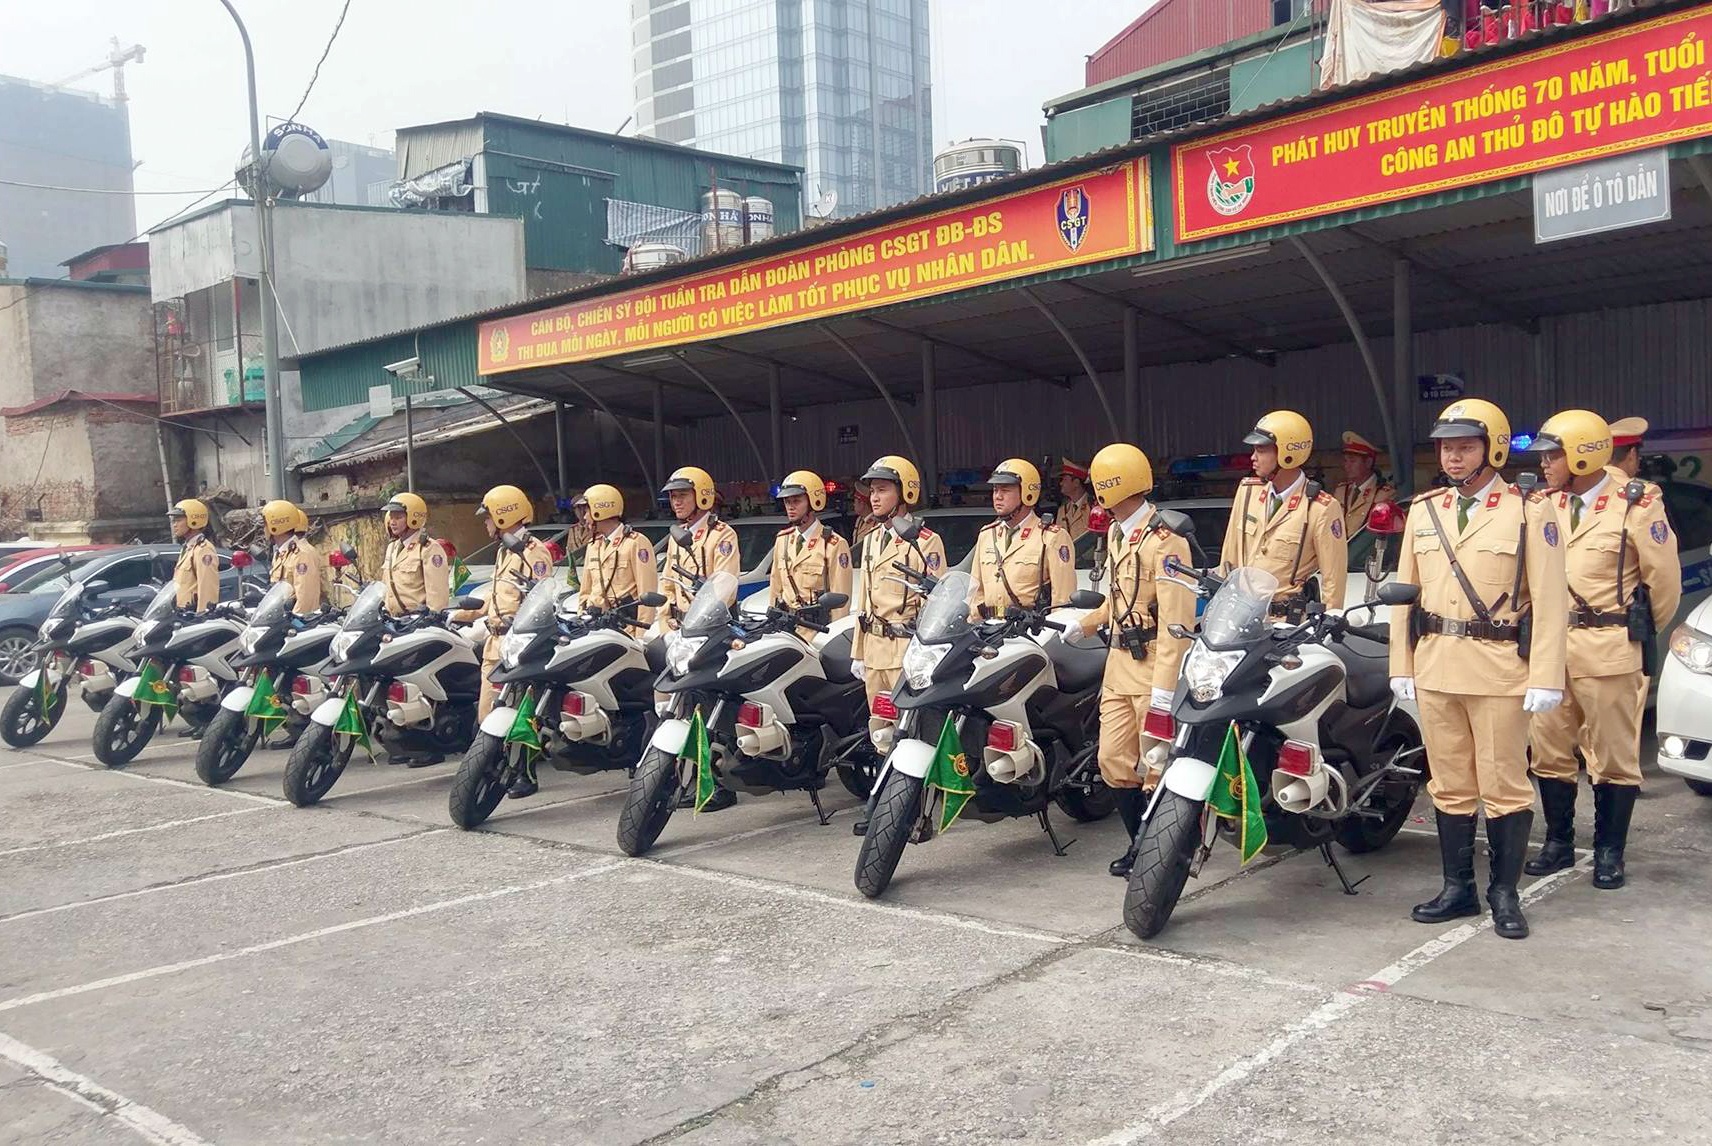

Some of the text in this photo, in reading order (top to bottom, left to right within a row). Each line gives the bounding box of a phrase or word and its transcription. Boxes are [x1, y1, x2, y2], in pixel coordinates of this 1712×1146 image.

[1272, 31, 1705, 166] PHÁT HUY TRUYỀN THỐNG 70 NĂM, TUỔI
[1381, 70, 1712, 177] CÔNG AN THỦ ĐÔ TỰ HÀO TIẾ
[1545, 187, 1568, 217] NƠI
[1572, 173, 1590, 213] ĐỂ
[1593, 176, 1603, 208] Ô
[1606, 171, 1623, 205] TÔ
[1060, 216, 1086, 230] CSGT
[556, 313, 574, 333] BỘ,
[577, 303, 613, 328] CHIẾN
[616, 300, 632, 320] SỸ
[634, 295, 656, 317] ĐỘI
[660, 285, 695, 311] TUẦN
[699, 281, 726, 302] TRA
[730, 269, 761, 296] DẪN
[765, 260, 810, 288] ĐOÀN
[815, 243, 876, 275] PHÒNG
[880, 230, 930, 260] CSGT
[935, 211, 1003, 247] ĐB-ĐS
[517, 239, 1036, 361] THI ĐUA MỖI NGÀY, MỖI NGƯỜI CÓ VIỆC LÀM TỐT PHỤC VỤ NHÂN DÂN.
[1285, 440, 1312, 452] CSGT
[1496, 433, 1510, 445] CS
[1576, 438, 1610, 454] CSGT
[1095, 476, 1122, 491] CSGT
[495, 502, 519, 516] CSGT
[593, 501, 616, 509] CSGT
